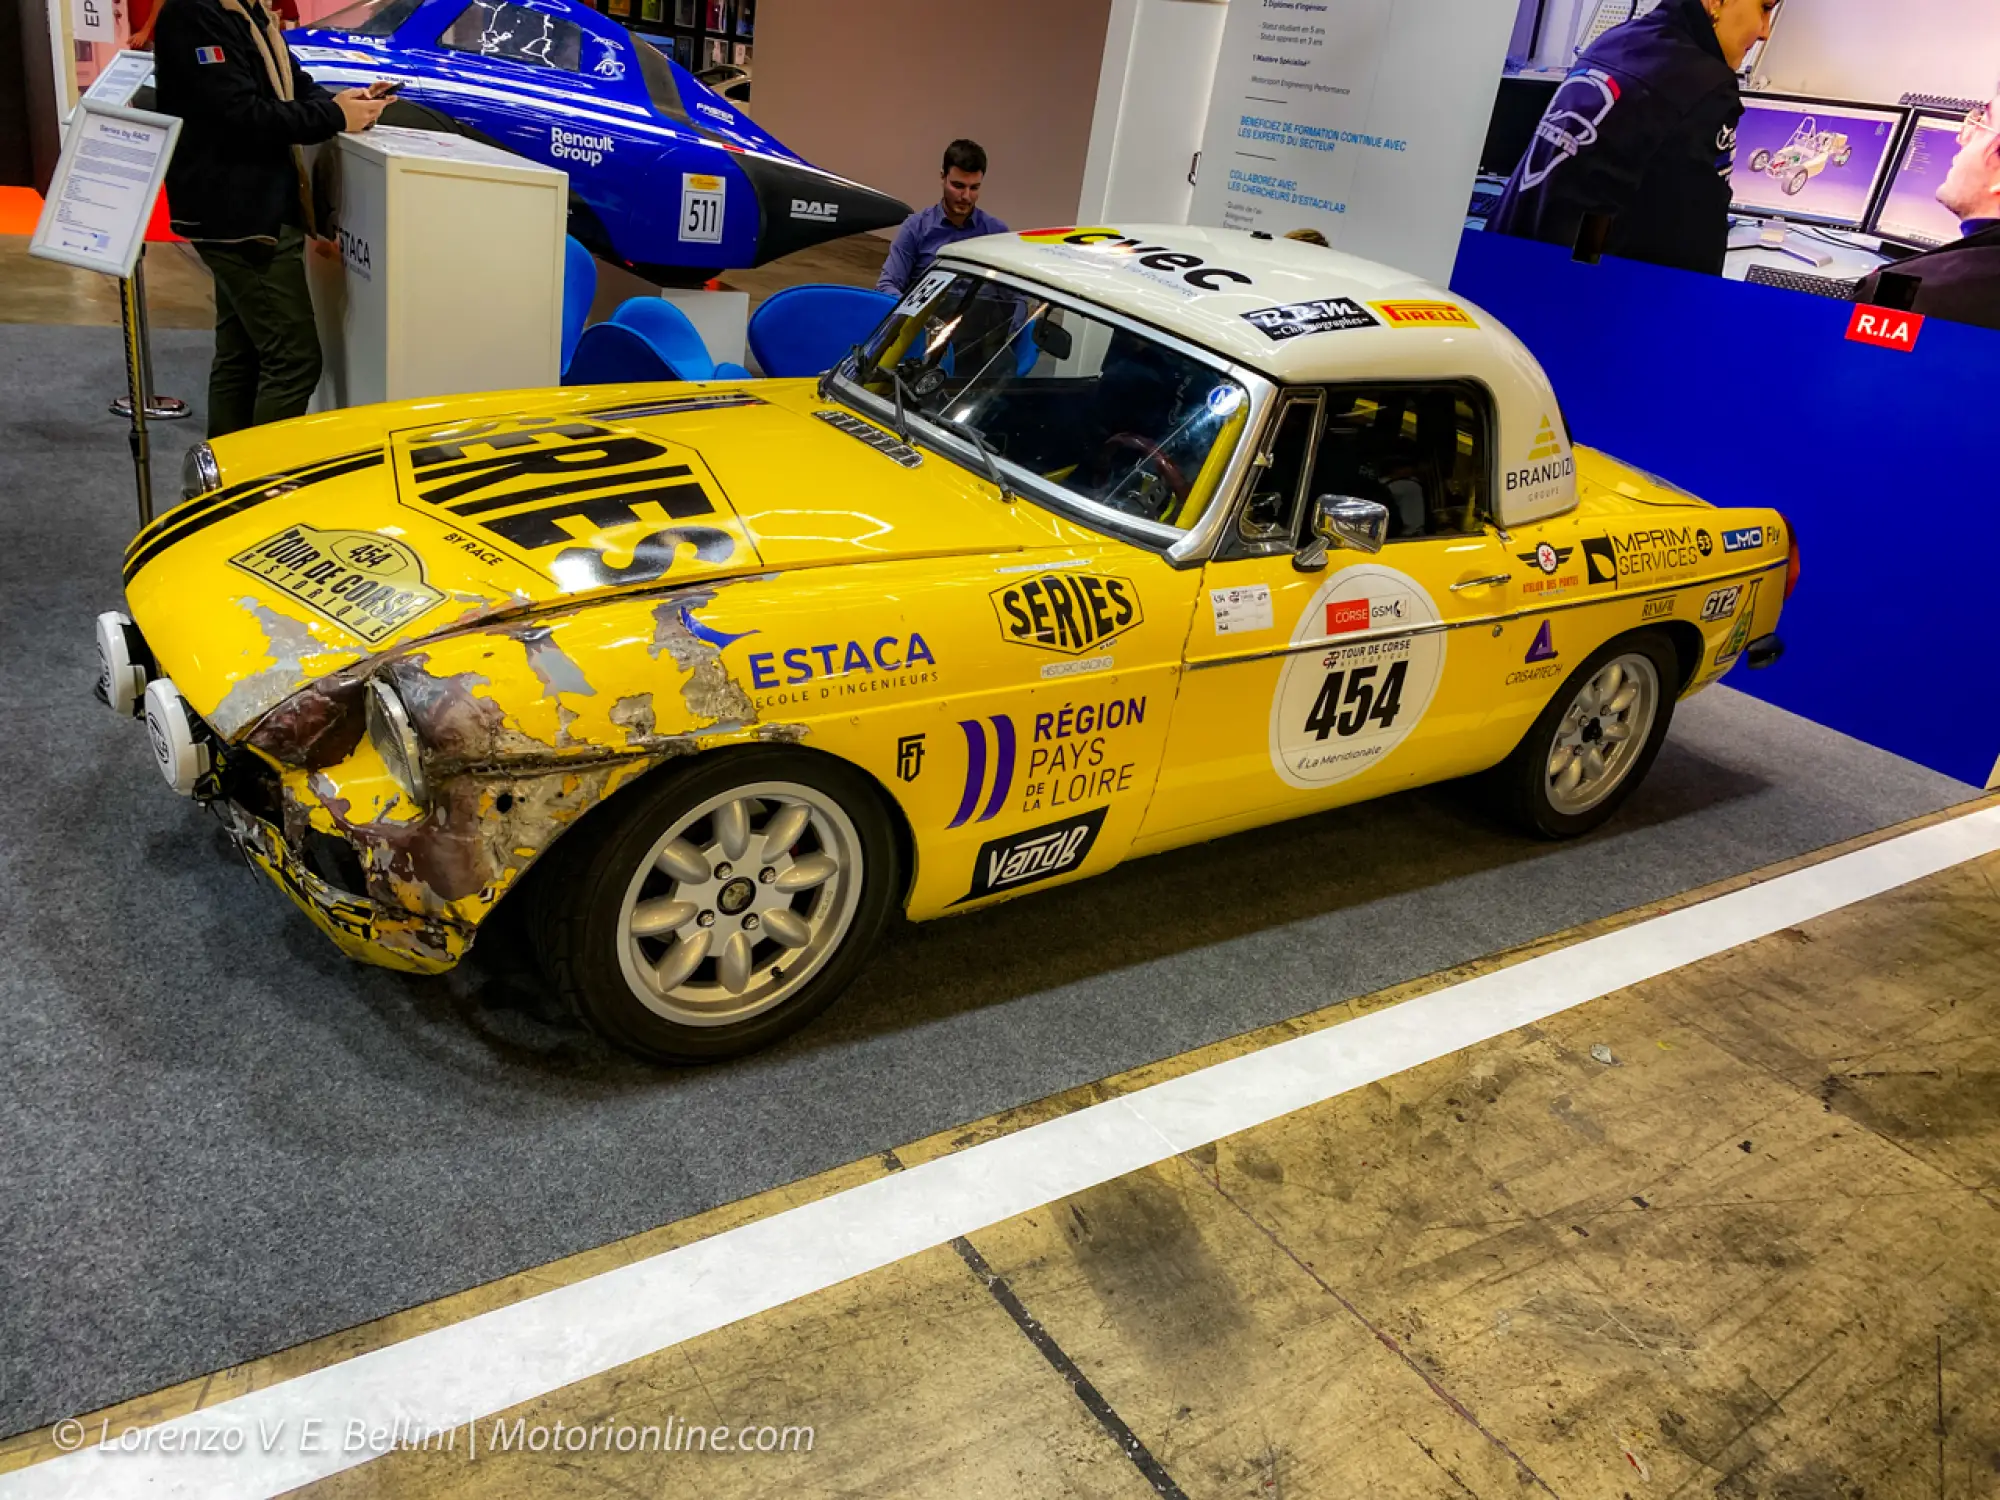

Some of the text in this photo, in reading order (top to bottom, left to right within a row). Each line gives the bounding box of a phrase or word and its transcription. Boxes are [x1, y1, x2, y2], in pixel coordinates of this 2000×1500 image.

[133, 130, 150, 142] RACE
[552, 127, 614, 152] Renault
[1237, 128, 1336, 152] LES EXPERTS DU SECTEUR
[1283, 122, 1293, 133] DE
[1294, 125, 1339, 140] FORMATION
[1340, 130, 1382, 148] CONTINUE
[1384, 138, 1407, 152] AVEC
[552, 142, 602, 168] Group
[1228, 181, 1240, 192] LES
[1242, 183, 1290, 202] CHERCHEURS
[1230, 170, 1298, 192] COLLABOREZ AVEC
[688, 199, 716, 232] 511
[791, 199, 839, 215] DAF
[1380, 305, 1468, 323] PIRELLI
[1856, 314, 1908, 342] R.I.A
[406, 416, 736, 592] SERIES
[443, 532, 503, 568] BY RACE
[1698, 535, 1710, 551] 53
[1723, 530, 1762, 551] LMO
[348, 544, 392, 568] 454
[1618, 546, 1698, 575] SERVICES
[256, 529, 431, 626] TOUR DE CORSE
[1003, 574, 1134, 648] SERIES
[1336, 604, 1392, 624] CORSE GSM
[748, 632, 936, 690] ESTACA
[1341, 639, 1412, 659] TOUR DE CORSE
[1042, 660, 1078, 676] HISTORIC
[755, 672, 939, 709] ECOLE D'INGENIEURS
[1303, 660, 1408, 742] 454
[1033, 696, 1147, 742] RÉGION
[1028, 737, 1106, 778] PAYS
[1025, 763, 1135, 807] DE LOIRE
[1022, 799, 1041, 813] LA
